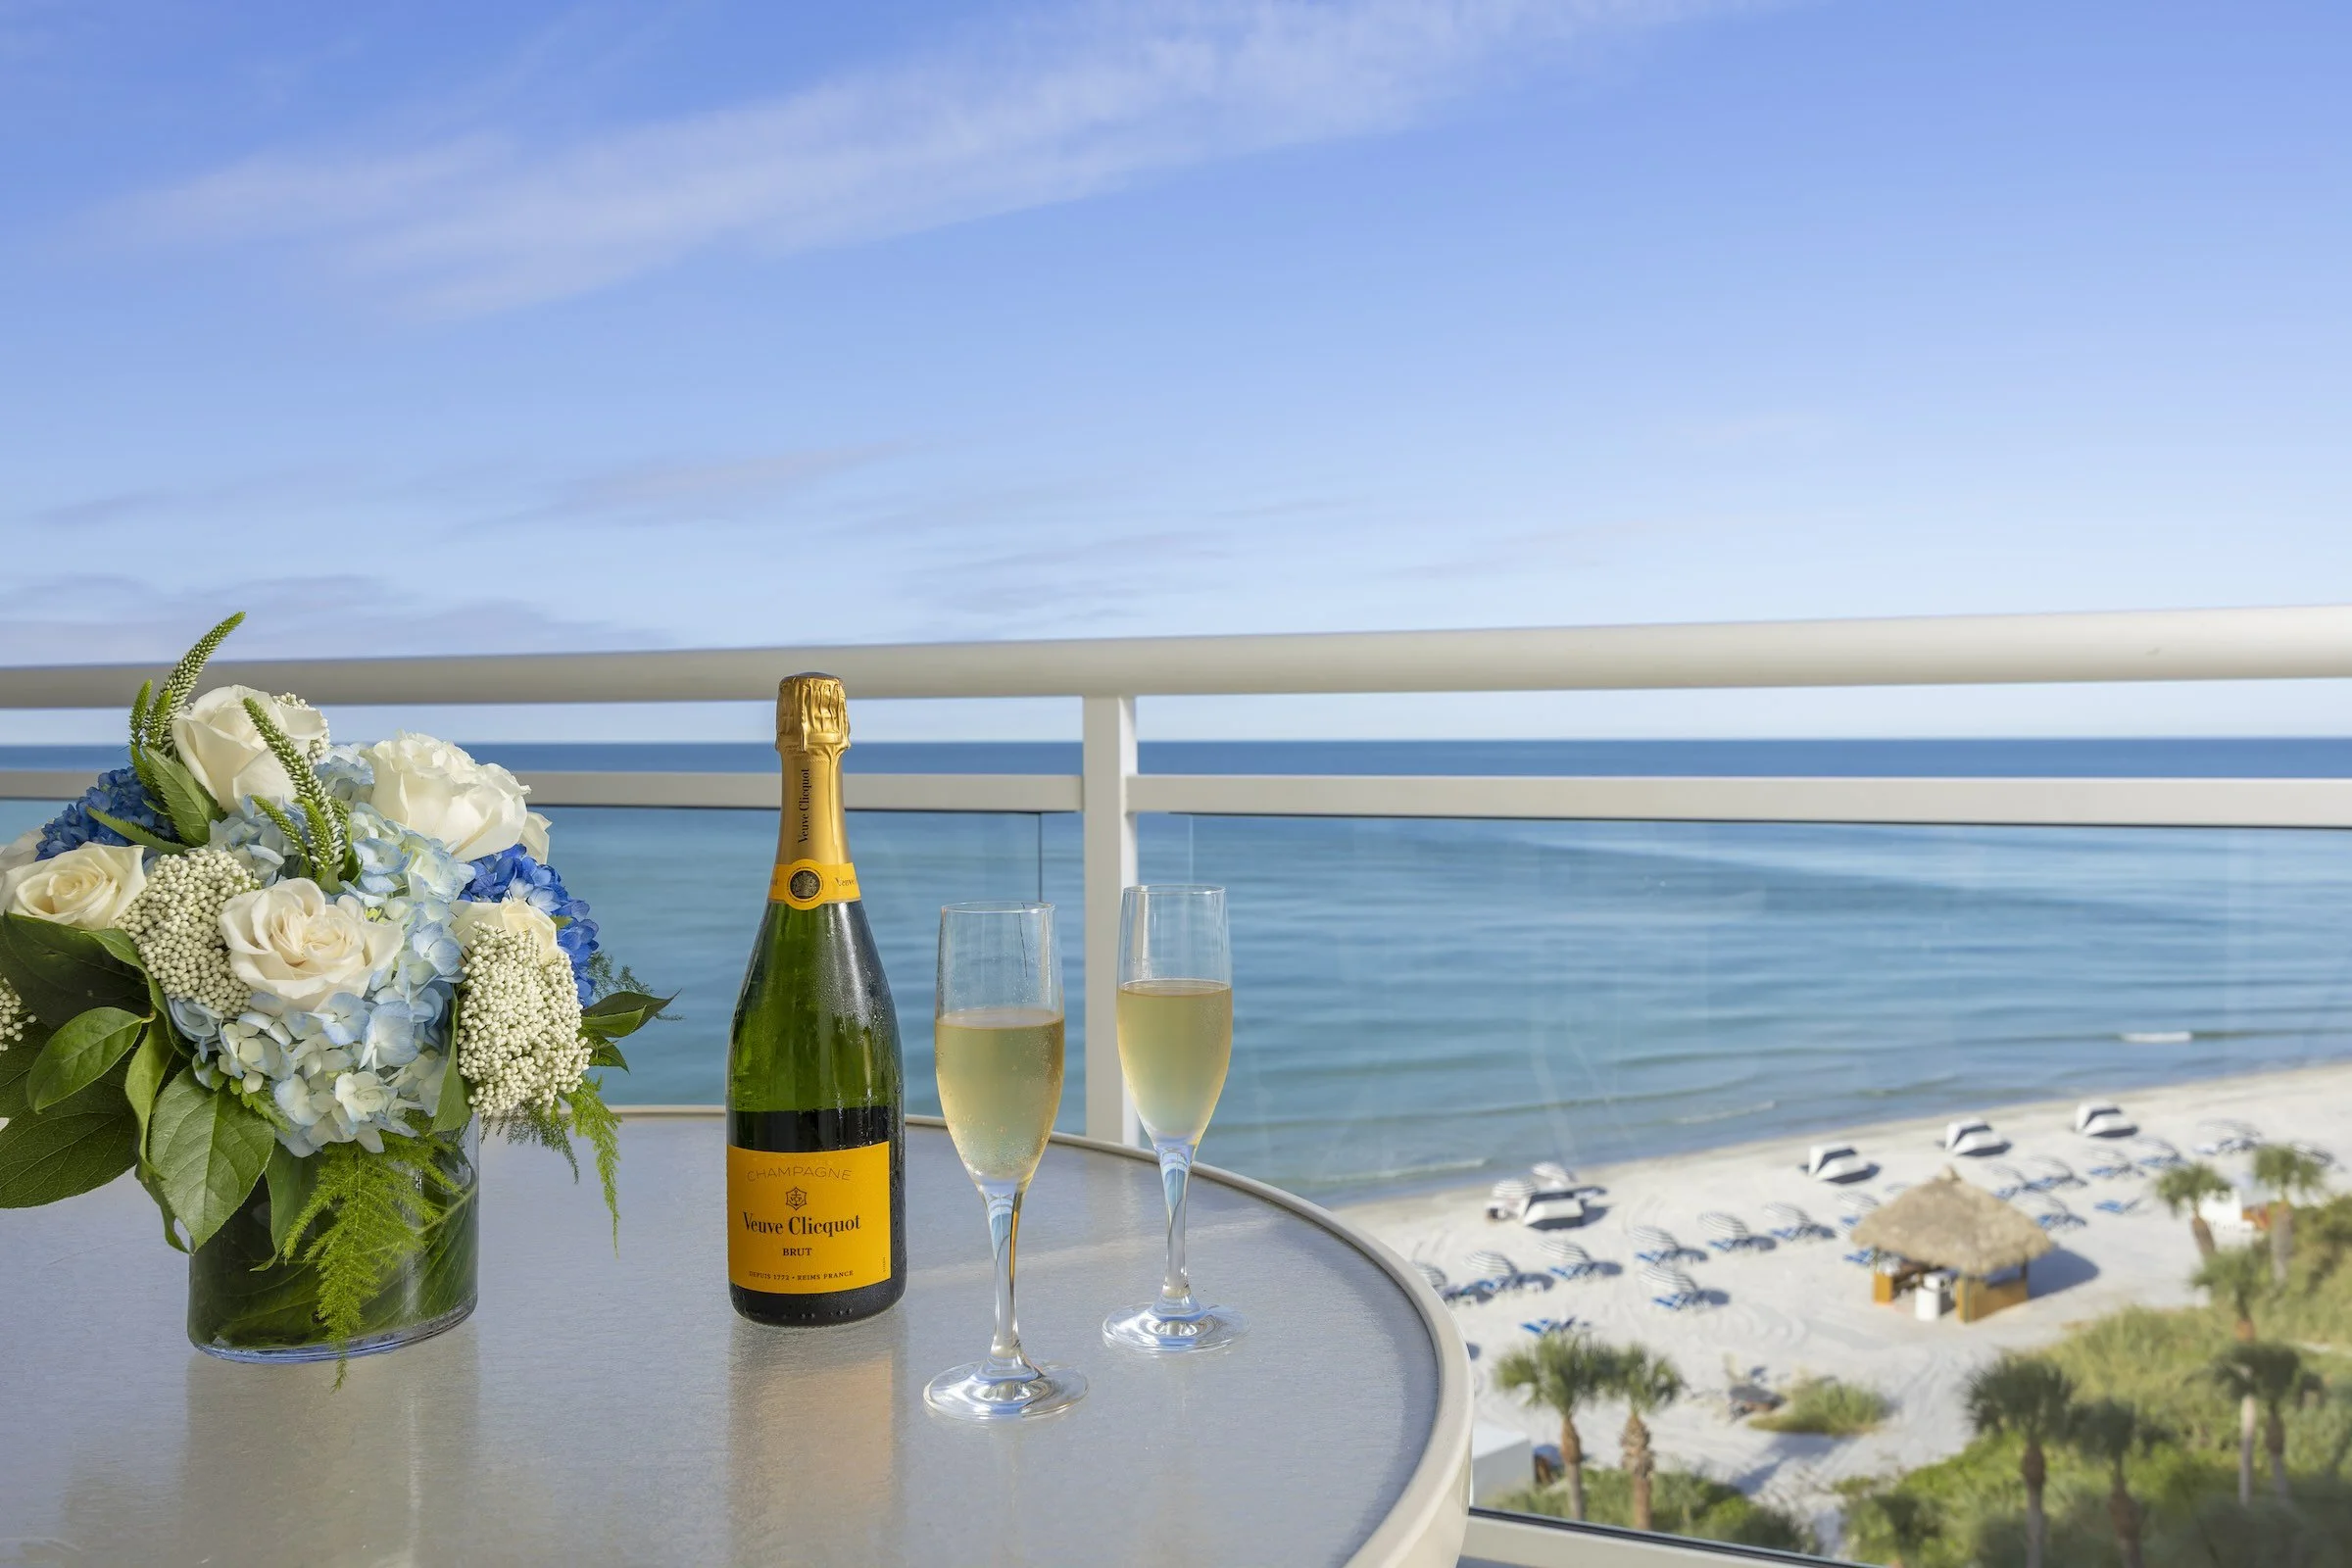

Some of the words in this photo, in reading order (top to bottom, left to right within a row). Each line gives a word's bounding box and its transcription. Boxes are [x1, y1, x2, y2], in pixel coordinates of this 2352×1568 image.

[799, 768, 811, 811] Clicquot
[798, 813, 808, 844] Veuve
[835, 877, 856, 887] Veuve
[748, 1166, 853, 1182] CHAMPAGNE
[744, 1212, 784, 1235] Veuve
[788, 1214, 861, 1238] Clicquot
[783, 1248, 812, 1256] BRUT
[749, 1270, 771, 1280] DEPUIS
[823, 1270, 854, 1280] FRANCE
